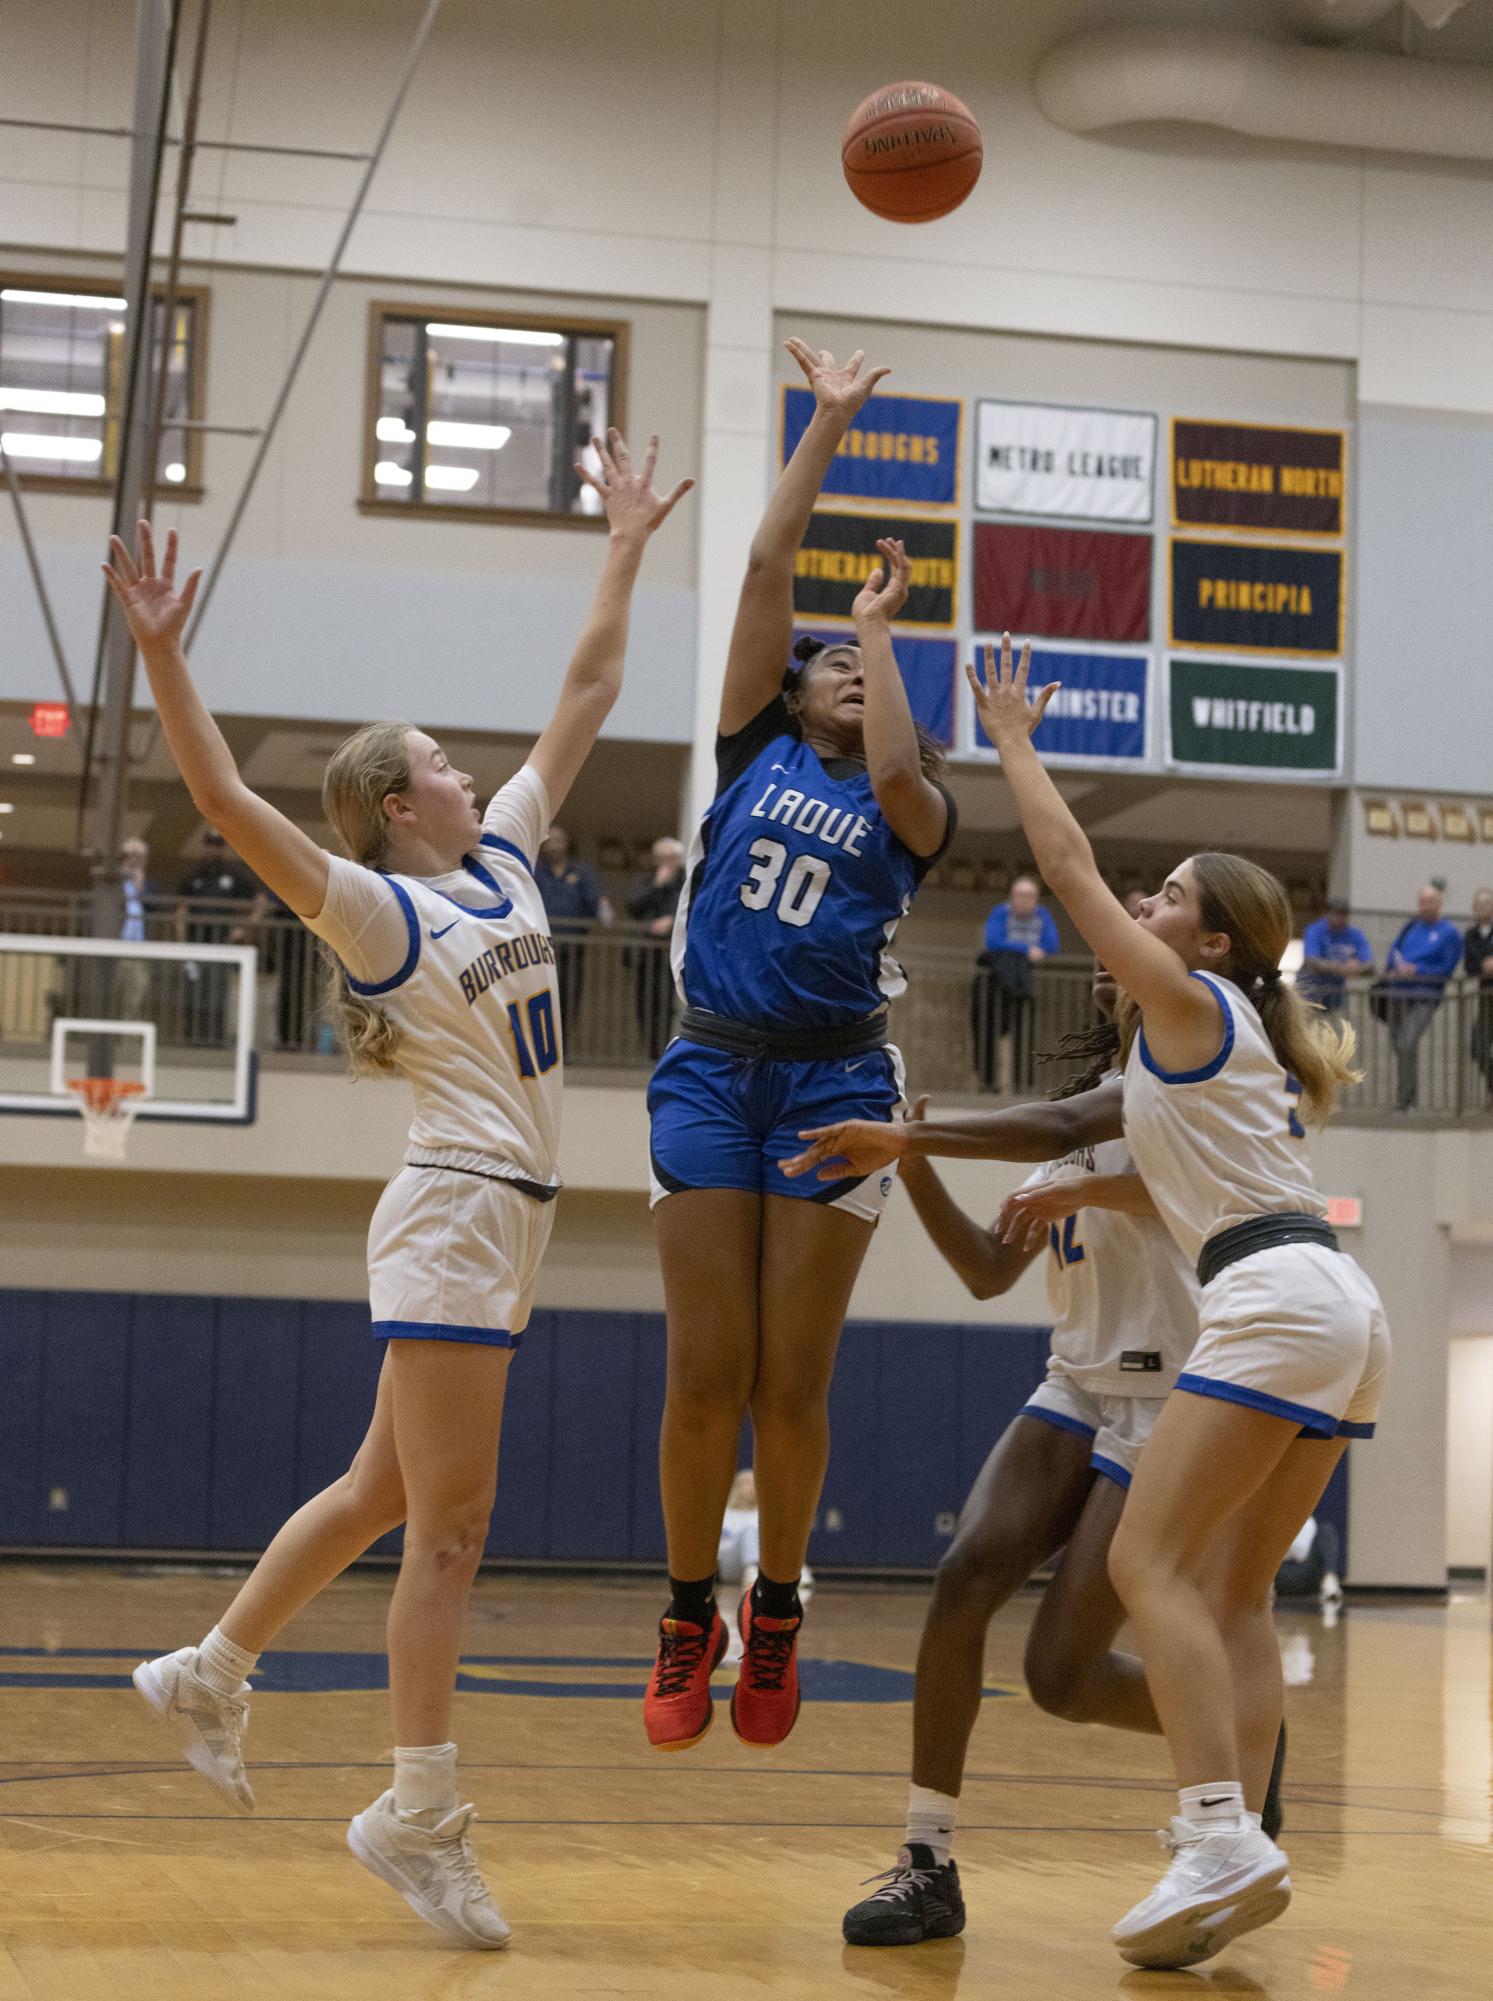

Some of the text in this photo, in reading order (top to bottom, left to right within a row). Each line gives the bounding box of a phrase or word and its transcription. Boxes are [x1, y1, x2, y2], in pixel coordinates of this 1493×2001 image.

[836, 429, 940, 465] ROUGHS
[988, 444, 1144, 481] METRO LEAGUE
[1176, 458, 1343, 499] LUTHERAN NORTH
[795, 548, 884, 584] UTHERAN
[1198, 576, 1313, 618] PRINCIPIA
[1028, 685, 1141, 723] MINSTER
[1191, 695, 1316, 736] WHITFIELD
[751, 783, 874, 858] LADUE
[740, 837, 832, 928] 30
[505, 988, 560, 1081] 10
